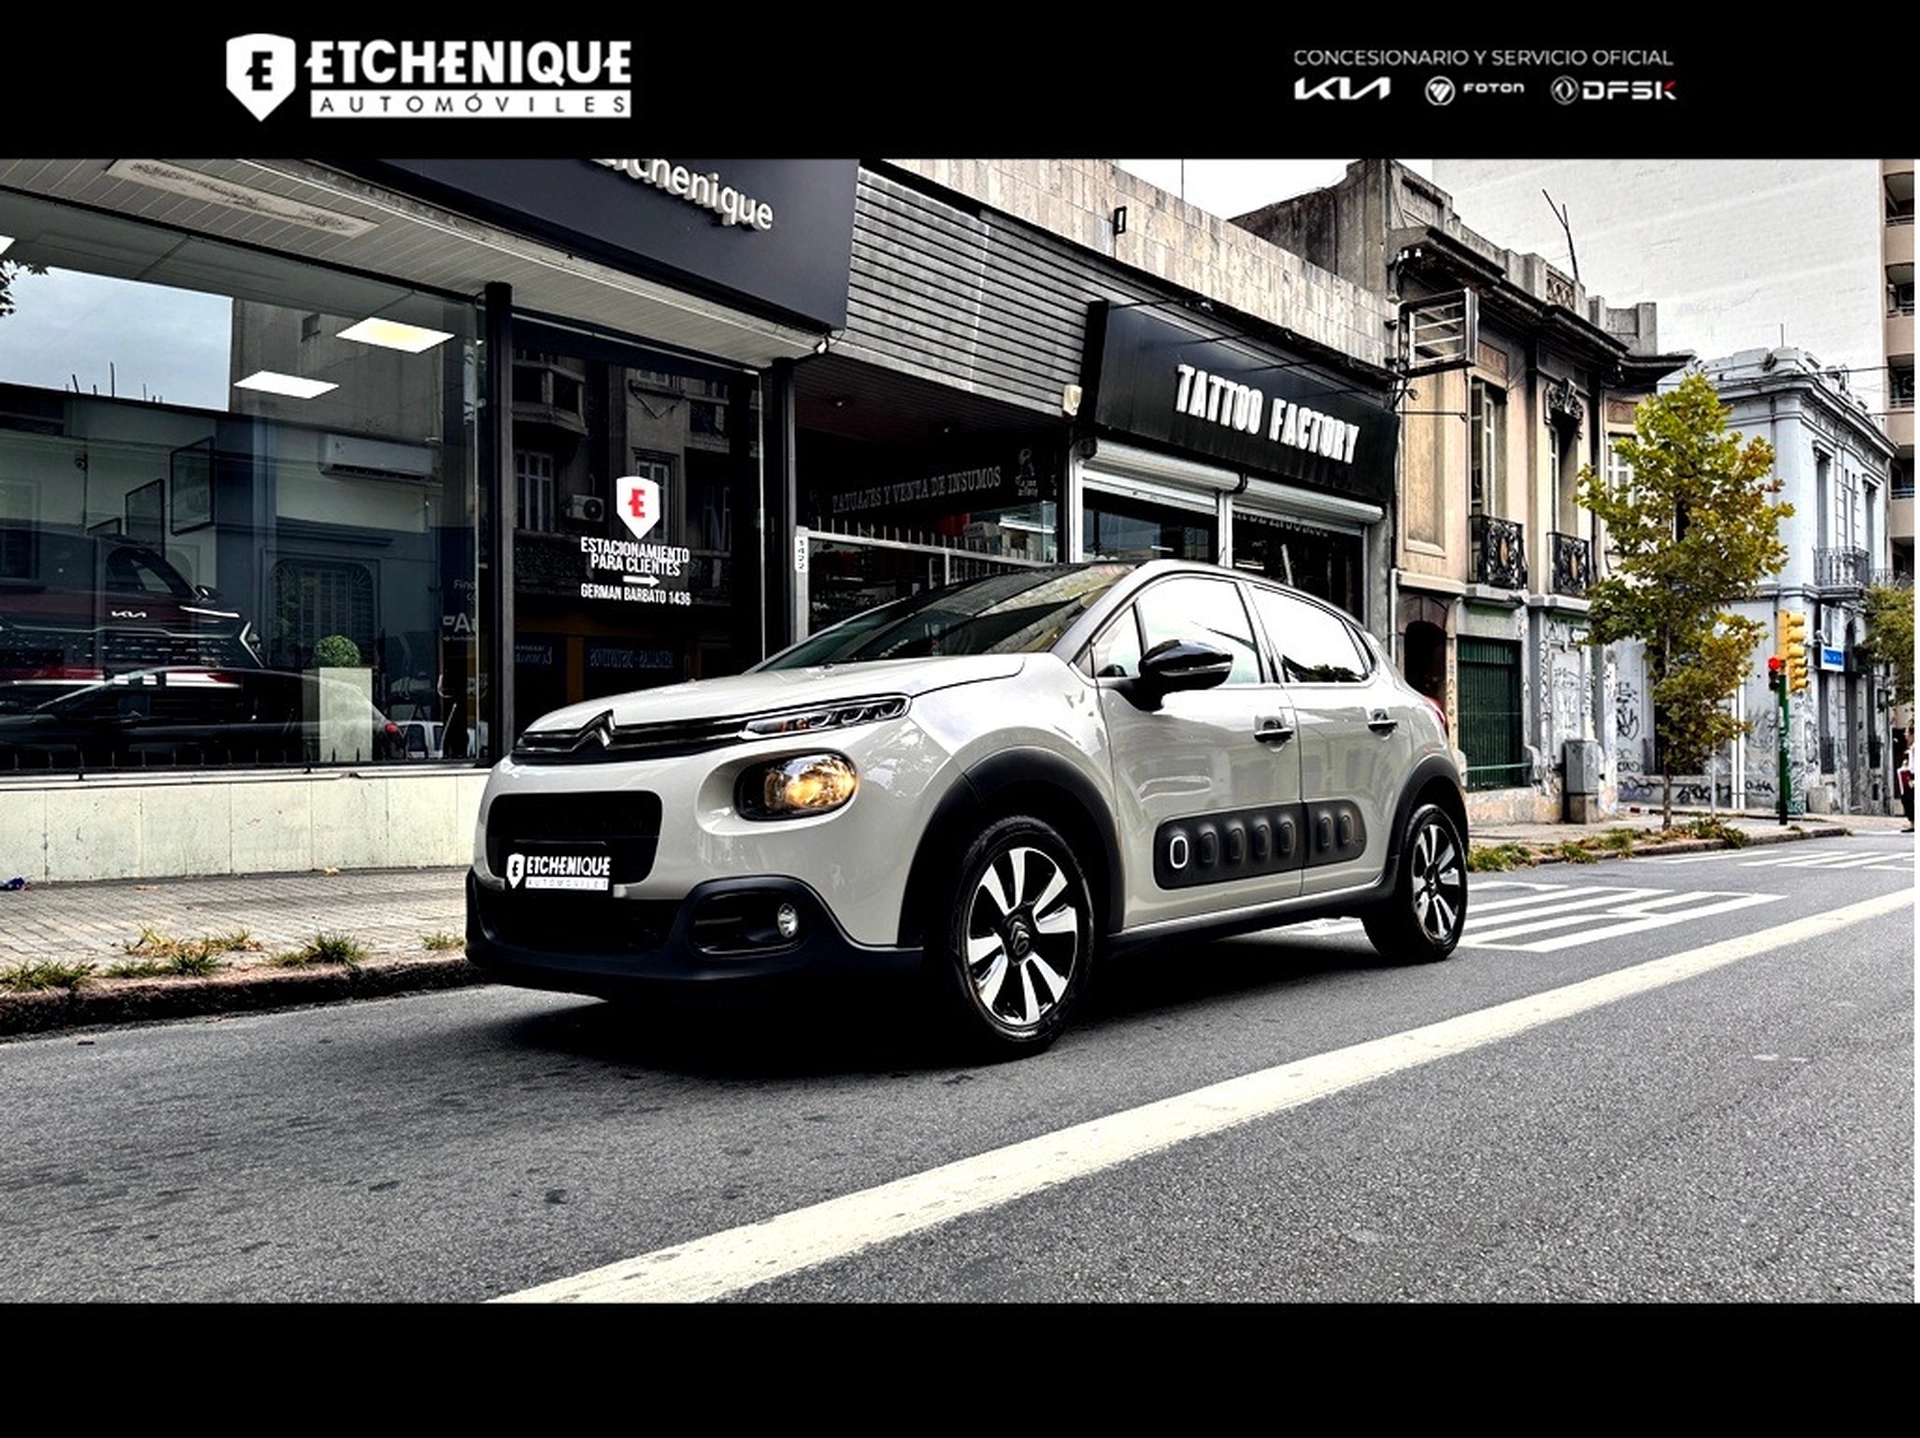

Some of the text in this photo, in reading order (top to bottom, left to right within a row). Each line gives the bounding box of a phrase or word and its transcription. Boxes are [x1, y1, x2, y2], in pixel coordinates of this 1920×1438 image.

[1175, 363, 1360, 465] TATTOO FACTORY
[832, 487, 882, 514] TATUAJES
[883, 485, 891, 503] Y
[892, 479, 929, 502] VENTA
[930, 476, 945, 497] DE
[948, 465, 1001, 494] INSUMOS
[580, 536, 690, 563] ESTACIONAMIENTO
[591, 553, 682, 577] PARA CLIENTES
[580, 583, 692, 606] GERMAN BARBATO 1436
[526, 855, 611, 876] ETCHENIQUE
